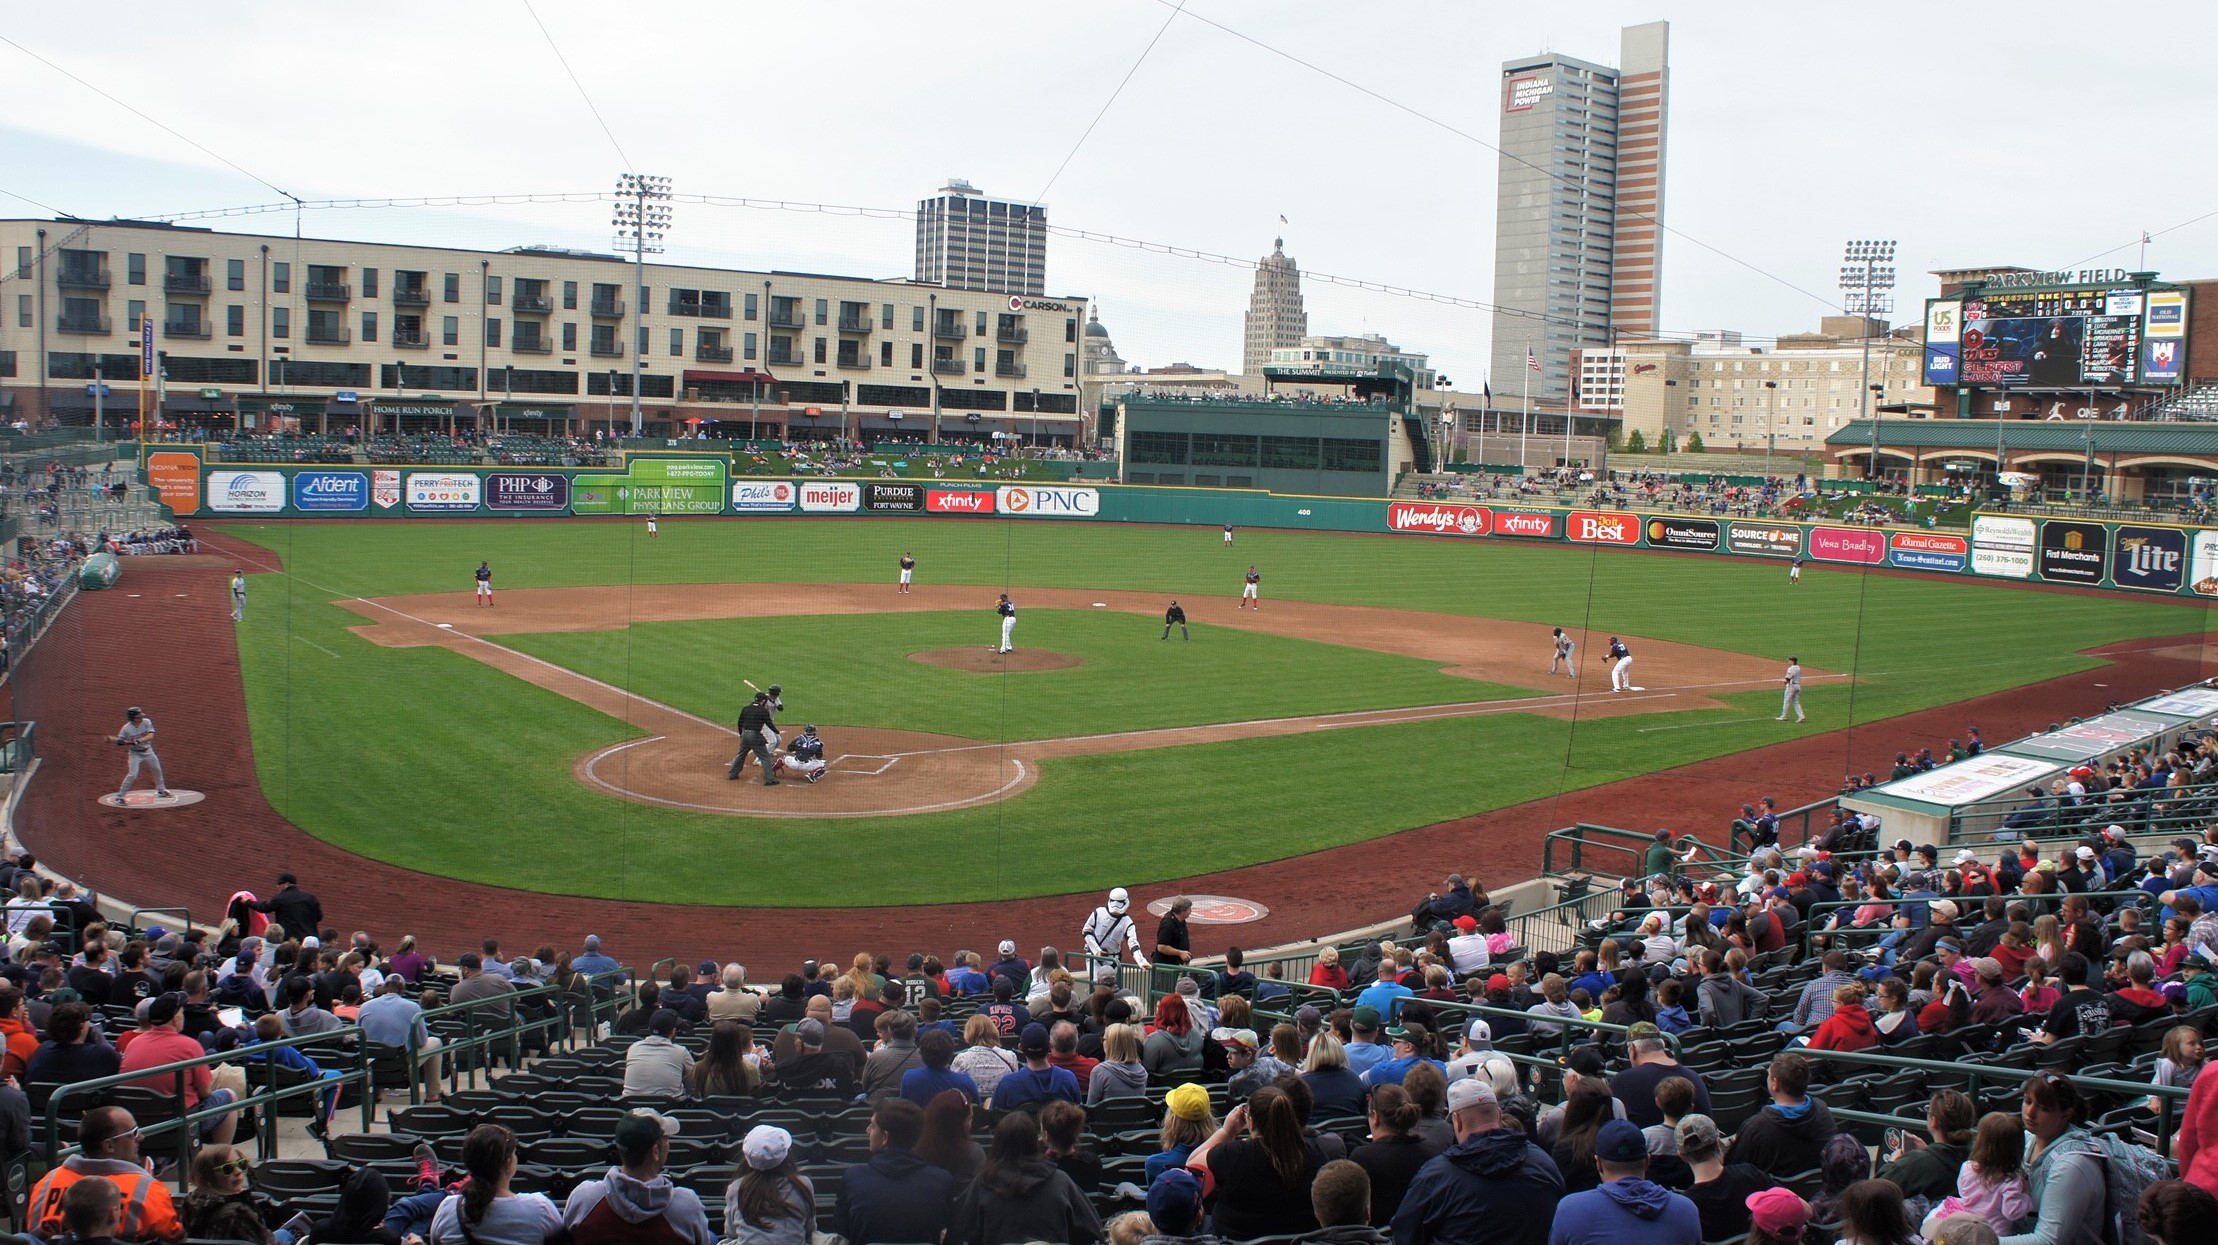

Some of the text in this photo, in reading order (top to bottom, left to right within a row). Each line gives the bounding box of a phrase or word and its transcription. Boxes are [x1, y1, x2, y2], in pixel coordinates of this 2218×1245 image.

[1516, 78, 1550, 91] INDIANA
[1515, 85, 1554, 99] MICHIGAN
[1514, 95, 1541, 107] POWER
[1985, 268, 2127, 289] PARKVIEW FIELD
[1023, 300, 1067, 312] CARSON
[2064, 298, 2103, 310] 0 0 0
[1292, 369, 1321, 377] SUMMIT
[1963, 361, 2024, 372] GILBERT
[1963, 371, 2003, 382] LARA
[270, 402, 295, 412] xfinity
[374, 405, 452, 415] HOME RUN PORCH
[522, 409, 542, 418] xfinity
[2077, 407, 2099, 419] ONE
[308, 476, 360, 493] Afdent
[499, 477, 531, 493] PHP
[228, 490, 267, 498] HORIZON
[633, 488, 694, 500] PARKVIEW
[741, 485, 771, 501] Phil's
[806, 486, 853, 507] meijer
[633, 501, 720, 511] PHYSICIANS GROUP
[938, 494, 983, 510] xfinity
[1036, 491, 1090, 513] PNC
[1396, 507, 1456, 531] Wendy's
[1504, 516, 1550, 533] xfinity
[1580, 518, 1625, 540] Best
[1666, 527, 1717, 539] OmniSource
[1731, 528, 1799, 542] SOURCE ONE
[1818, 538, 1876, 557] Vera Bradley
[1900, 536, 1957, 550] Journal Gazette
[1976, 554, 1994, 563] (260)
[2046, 550, 2100, 562] First Merchants
[2127, 543, 2179, 577] Lite
[904, 985, 926, 1006] 12
